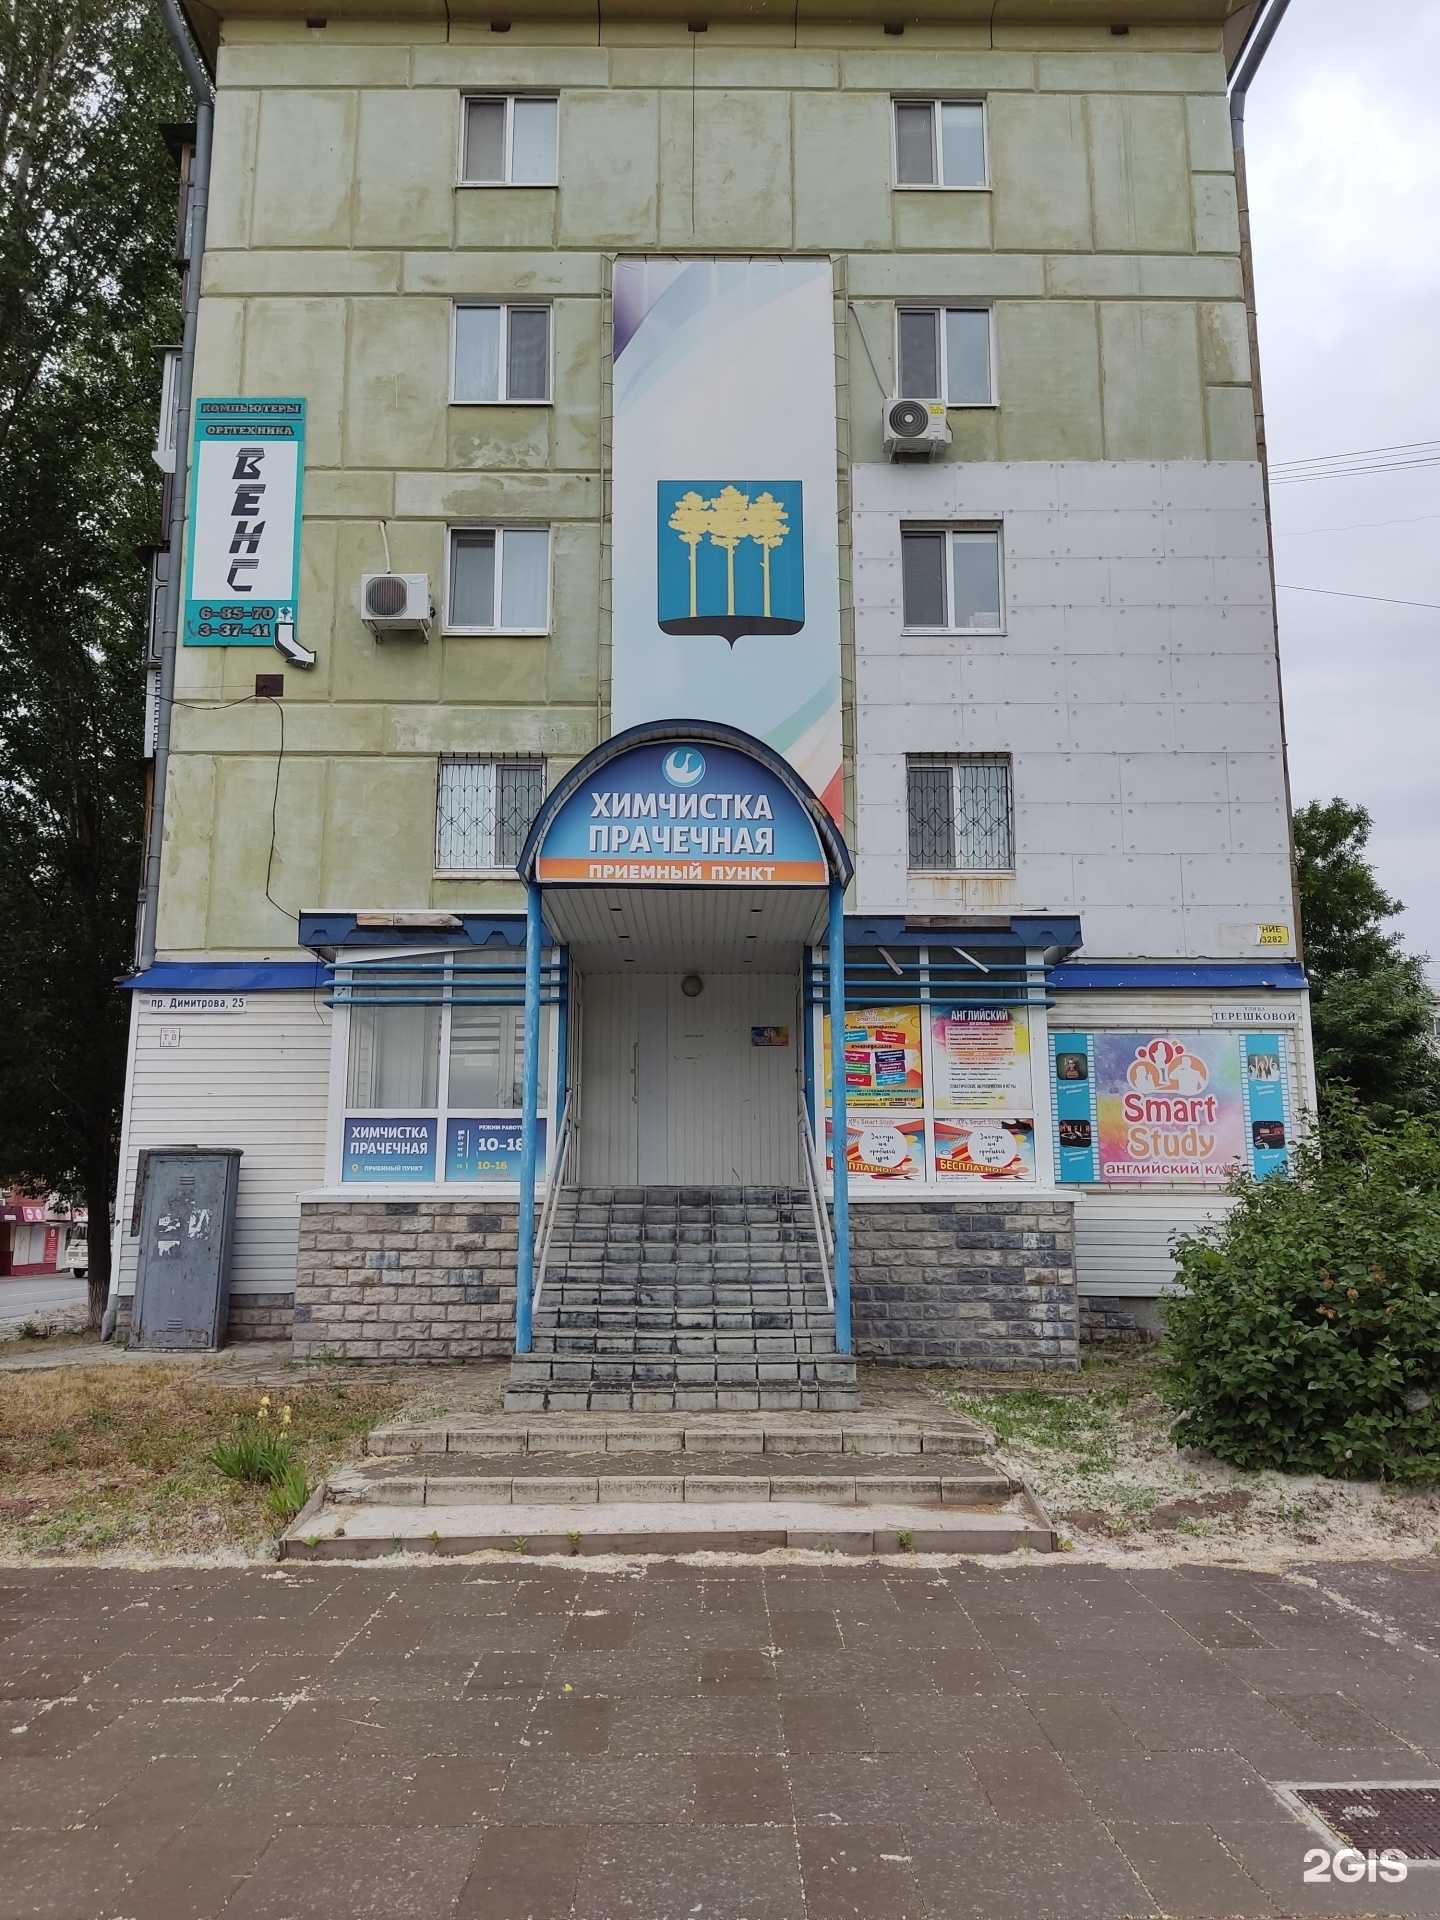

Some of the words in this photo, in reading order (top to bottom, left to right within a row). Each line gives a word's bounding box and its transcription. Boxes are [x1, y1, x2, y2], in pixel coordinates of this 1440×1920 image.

[202, 403, 300, 413] КОМПЬЮТЕРЫ
[207, 426, 294, 435] ОРГТЕХНИКА
[199, 624, 271, 637] 3-37-41
[591, 792, 774, 820] ХИМЧИСТКА
[589, 825, 774, 855] ПРАЧЕЧНАЯ
[589, 863, 702, 880] ПРИЕМНЫЙ
[711, 866, 775, 881] ПУНКТ
[151, 998, 166, 1009] пр.
[169, 998, 228, 1008] Димитрова,
[232, 998, 244, 1008] 25
[951, 1008, 1008, 1021] АНГЛИЙСКИЙ
[1215, 1010, 1296, 1021] ТЕРЕШКОВОЙ
[1124, 1093, 1216, 1122] Smart
[351, 1126, 428, 1139] ХИМЧИСТКА
[350, 1142, 428, 1155] ПРАЧЕЧНАЯ
[1129, 1127, 1215, 1157] Study
[1106, 1161, 1199, 1175] английский
